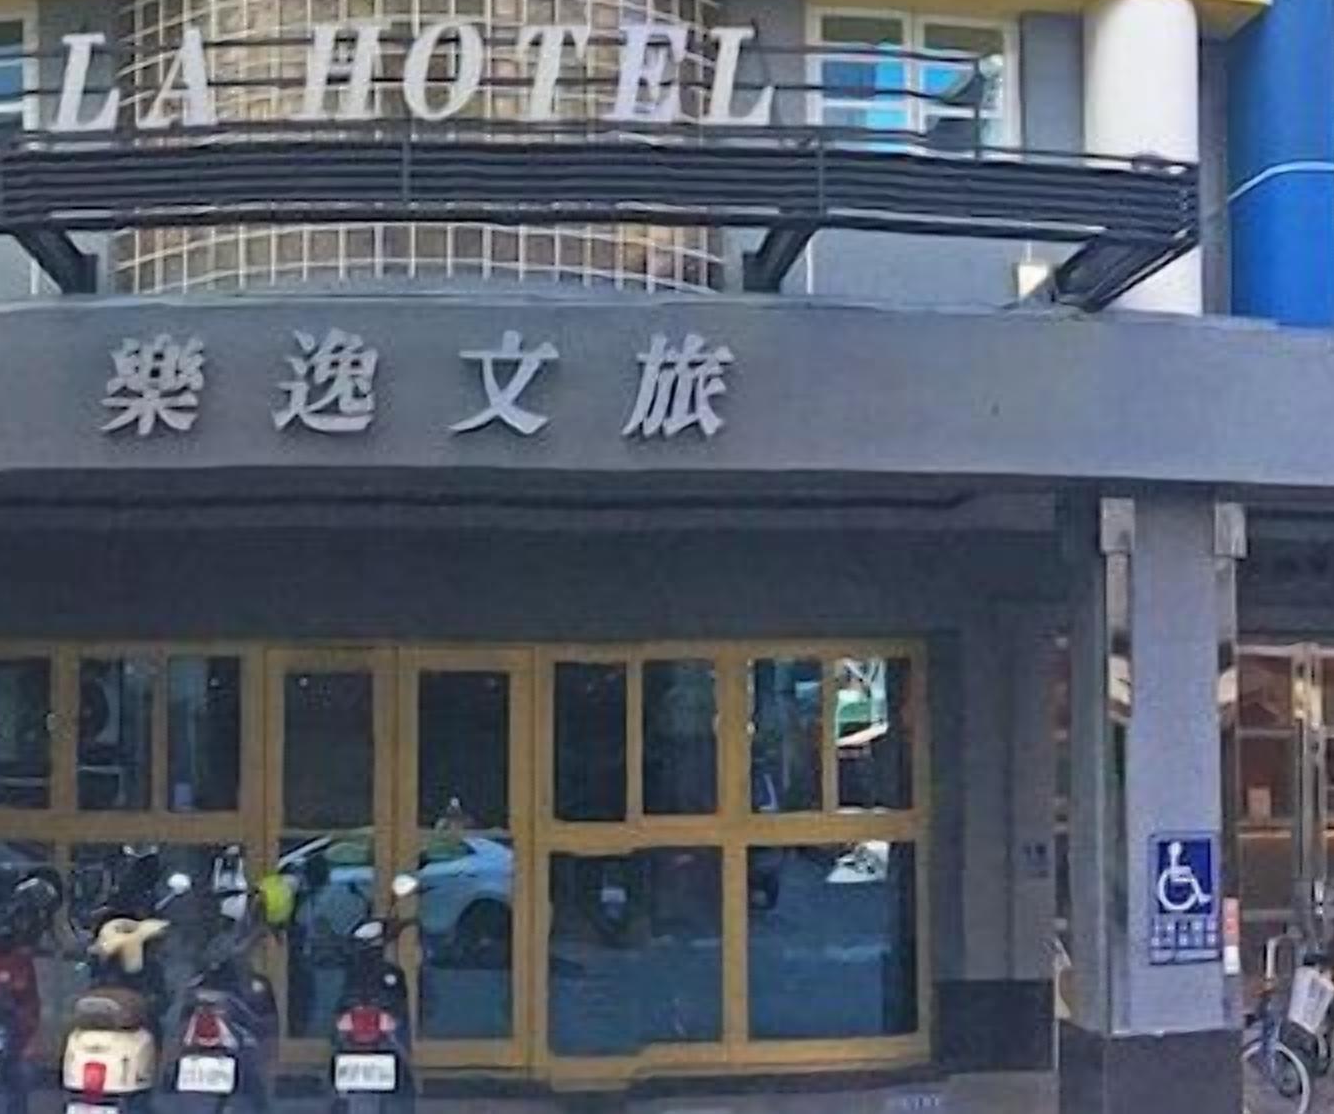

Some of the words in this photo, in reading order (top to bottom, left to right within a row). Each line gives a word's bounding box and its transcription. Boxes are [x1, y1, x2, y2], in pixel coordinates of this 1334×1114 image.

[50, 24, 219, 133] LA
[287, 16, 774, 129] HOTEL
[101, 327, 735, 438] 樂逸文旅
